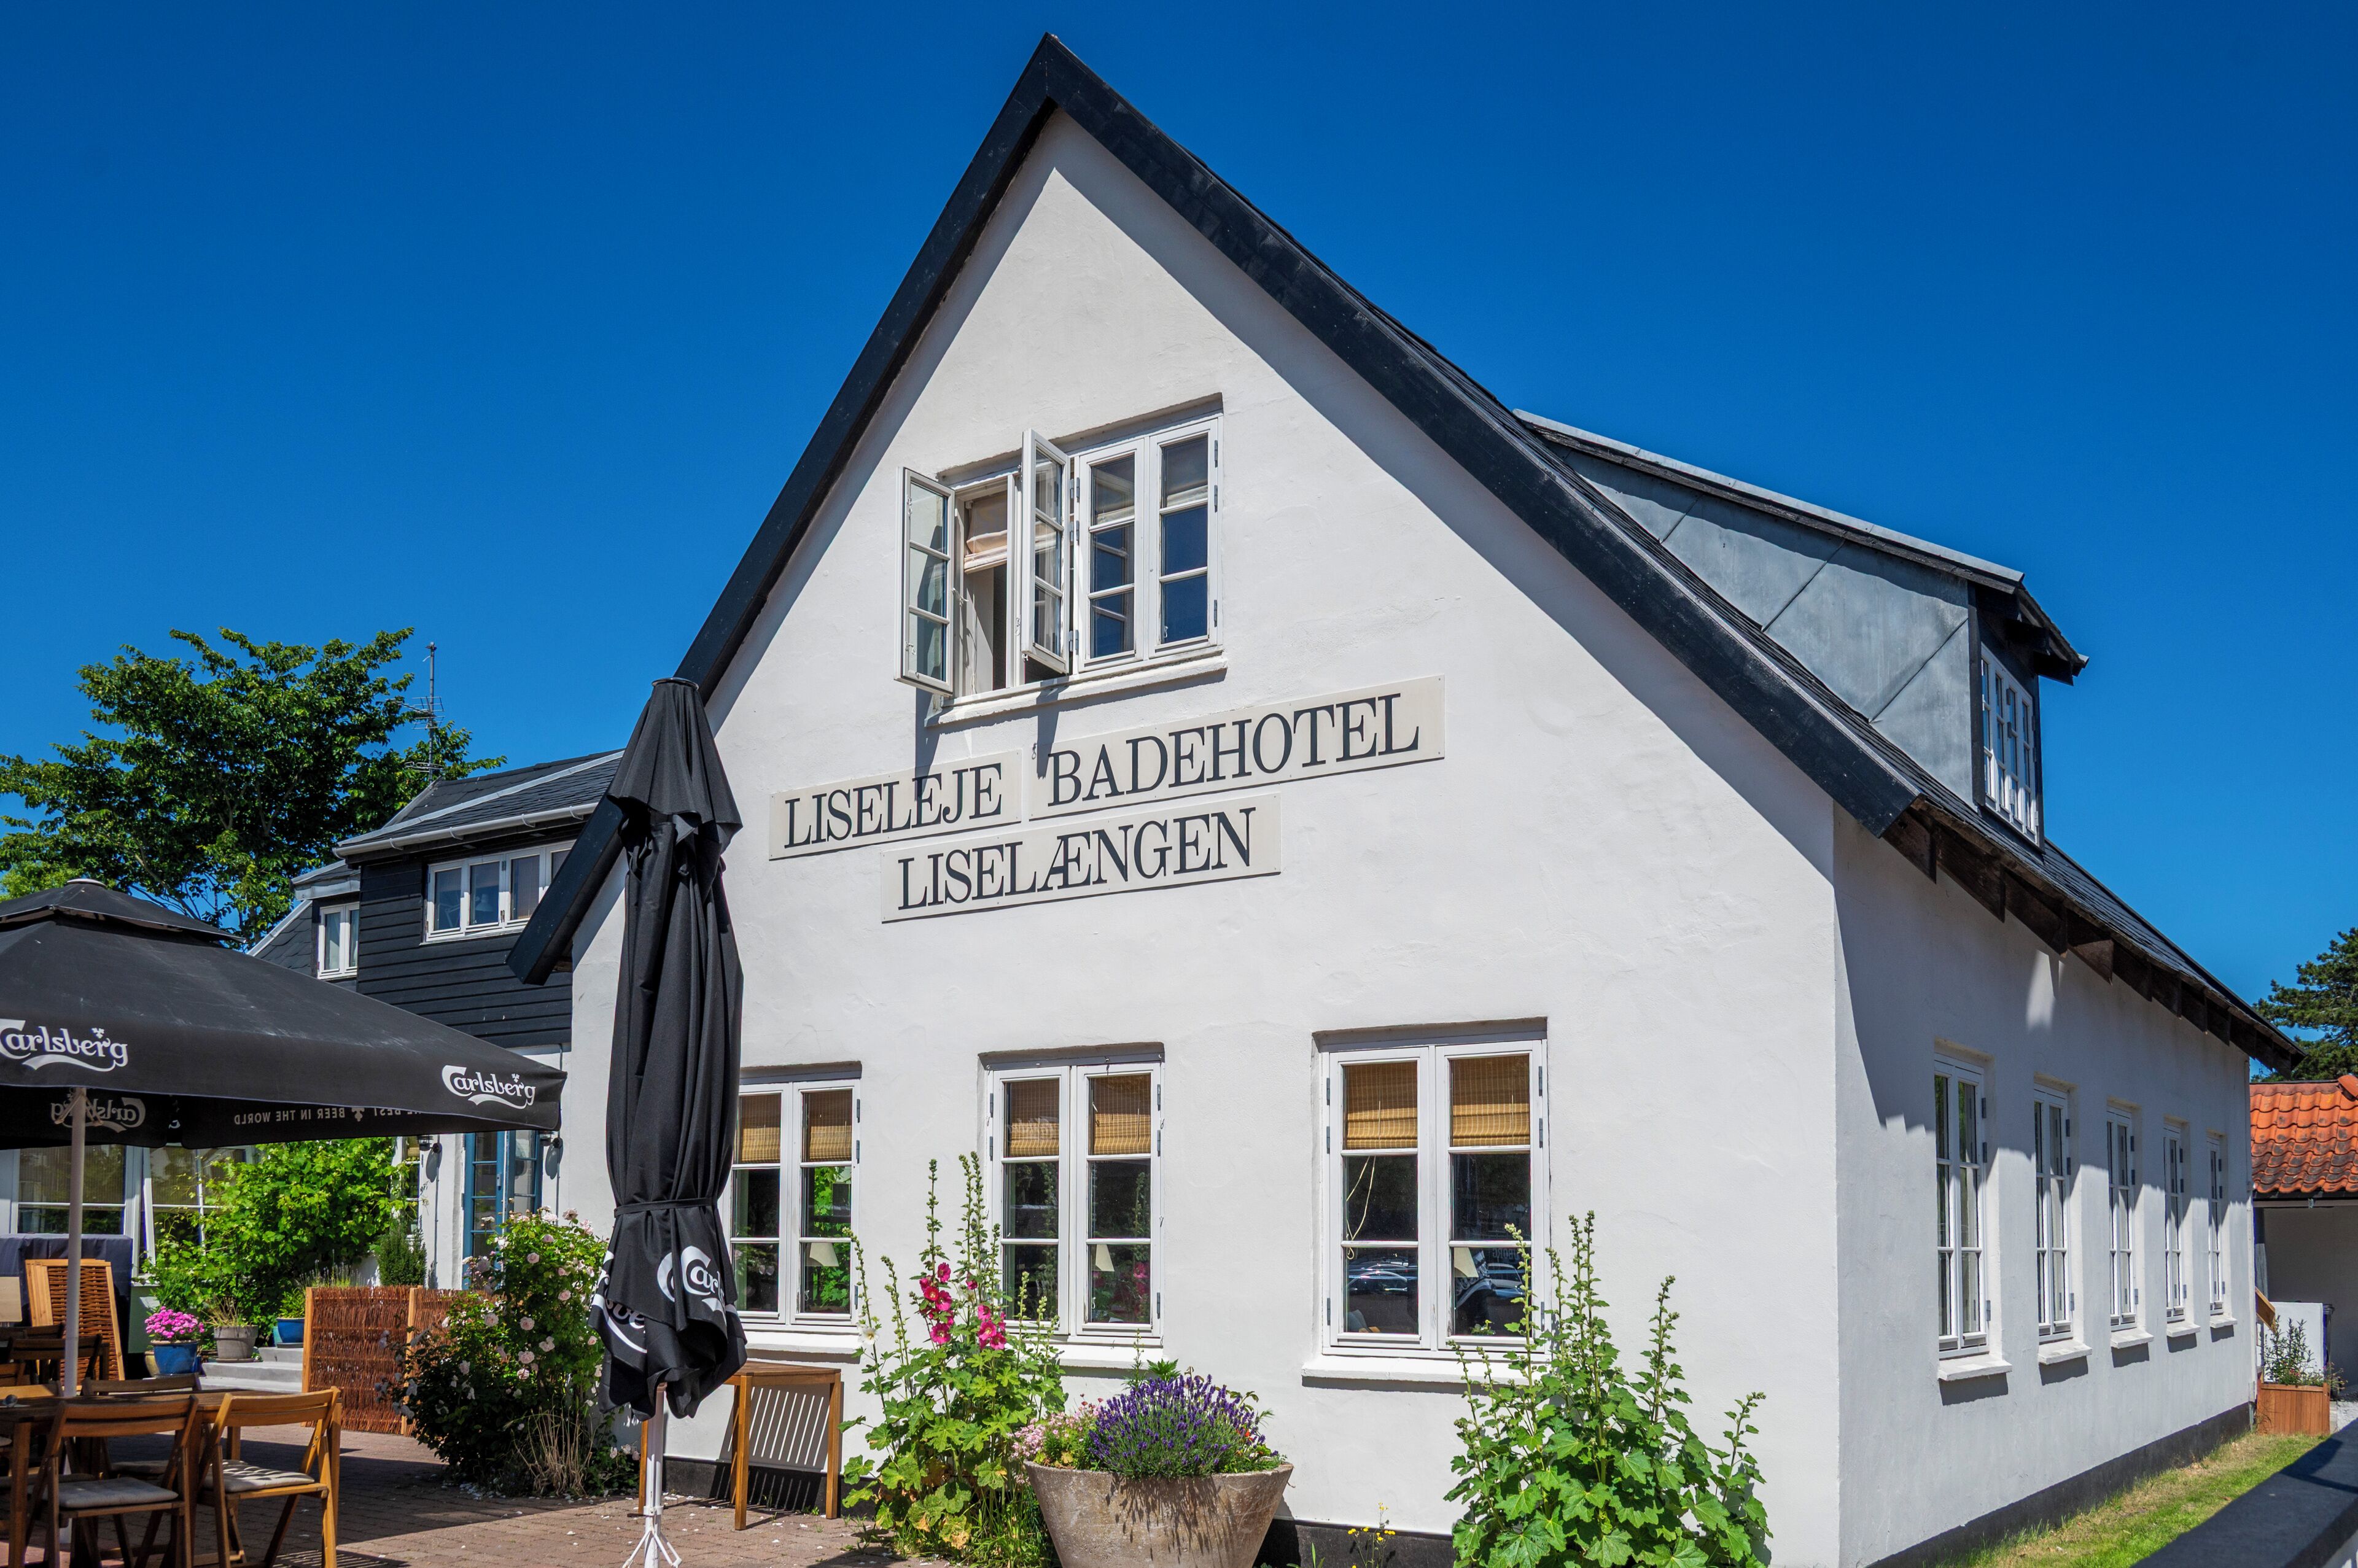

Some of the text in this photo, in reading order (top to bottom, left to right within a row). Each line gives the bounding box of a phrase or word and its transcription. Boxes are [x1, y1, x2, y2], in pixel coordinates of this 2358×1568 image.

[784, 693, 1419, 848] LISELEJE BADEHOTEL
[898, 807, 1256, 910] LISELÆNGEN
[0, 1019, 128, 1072] Carlsberg
[442, 1065, 536, 1109] Carlsberg
